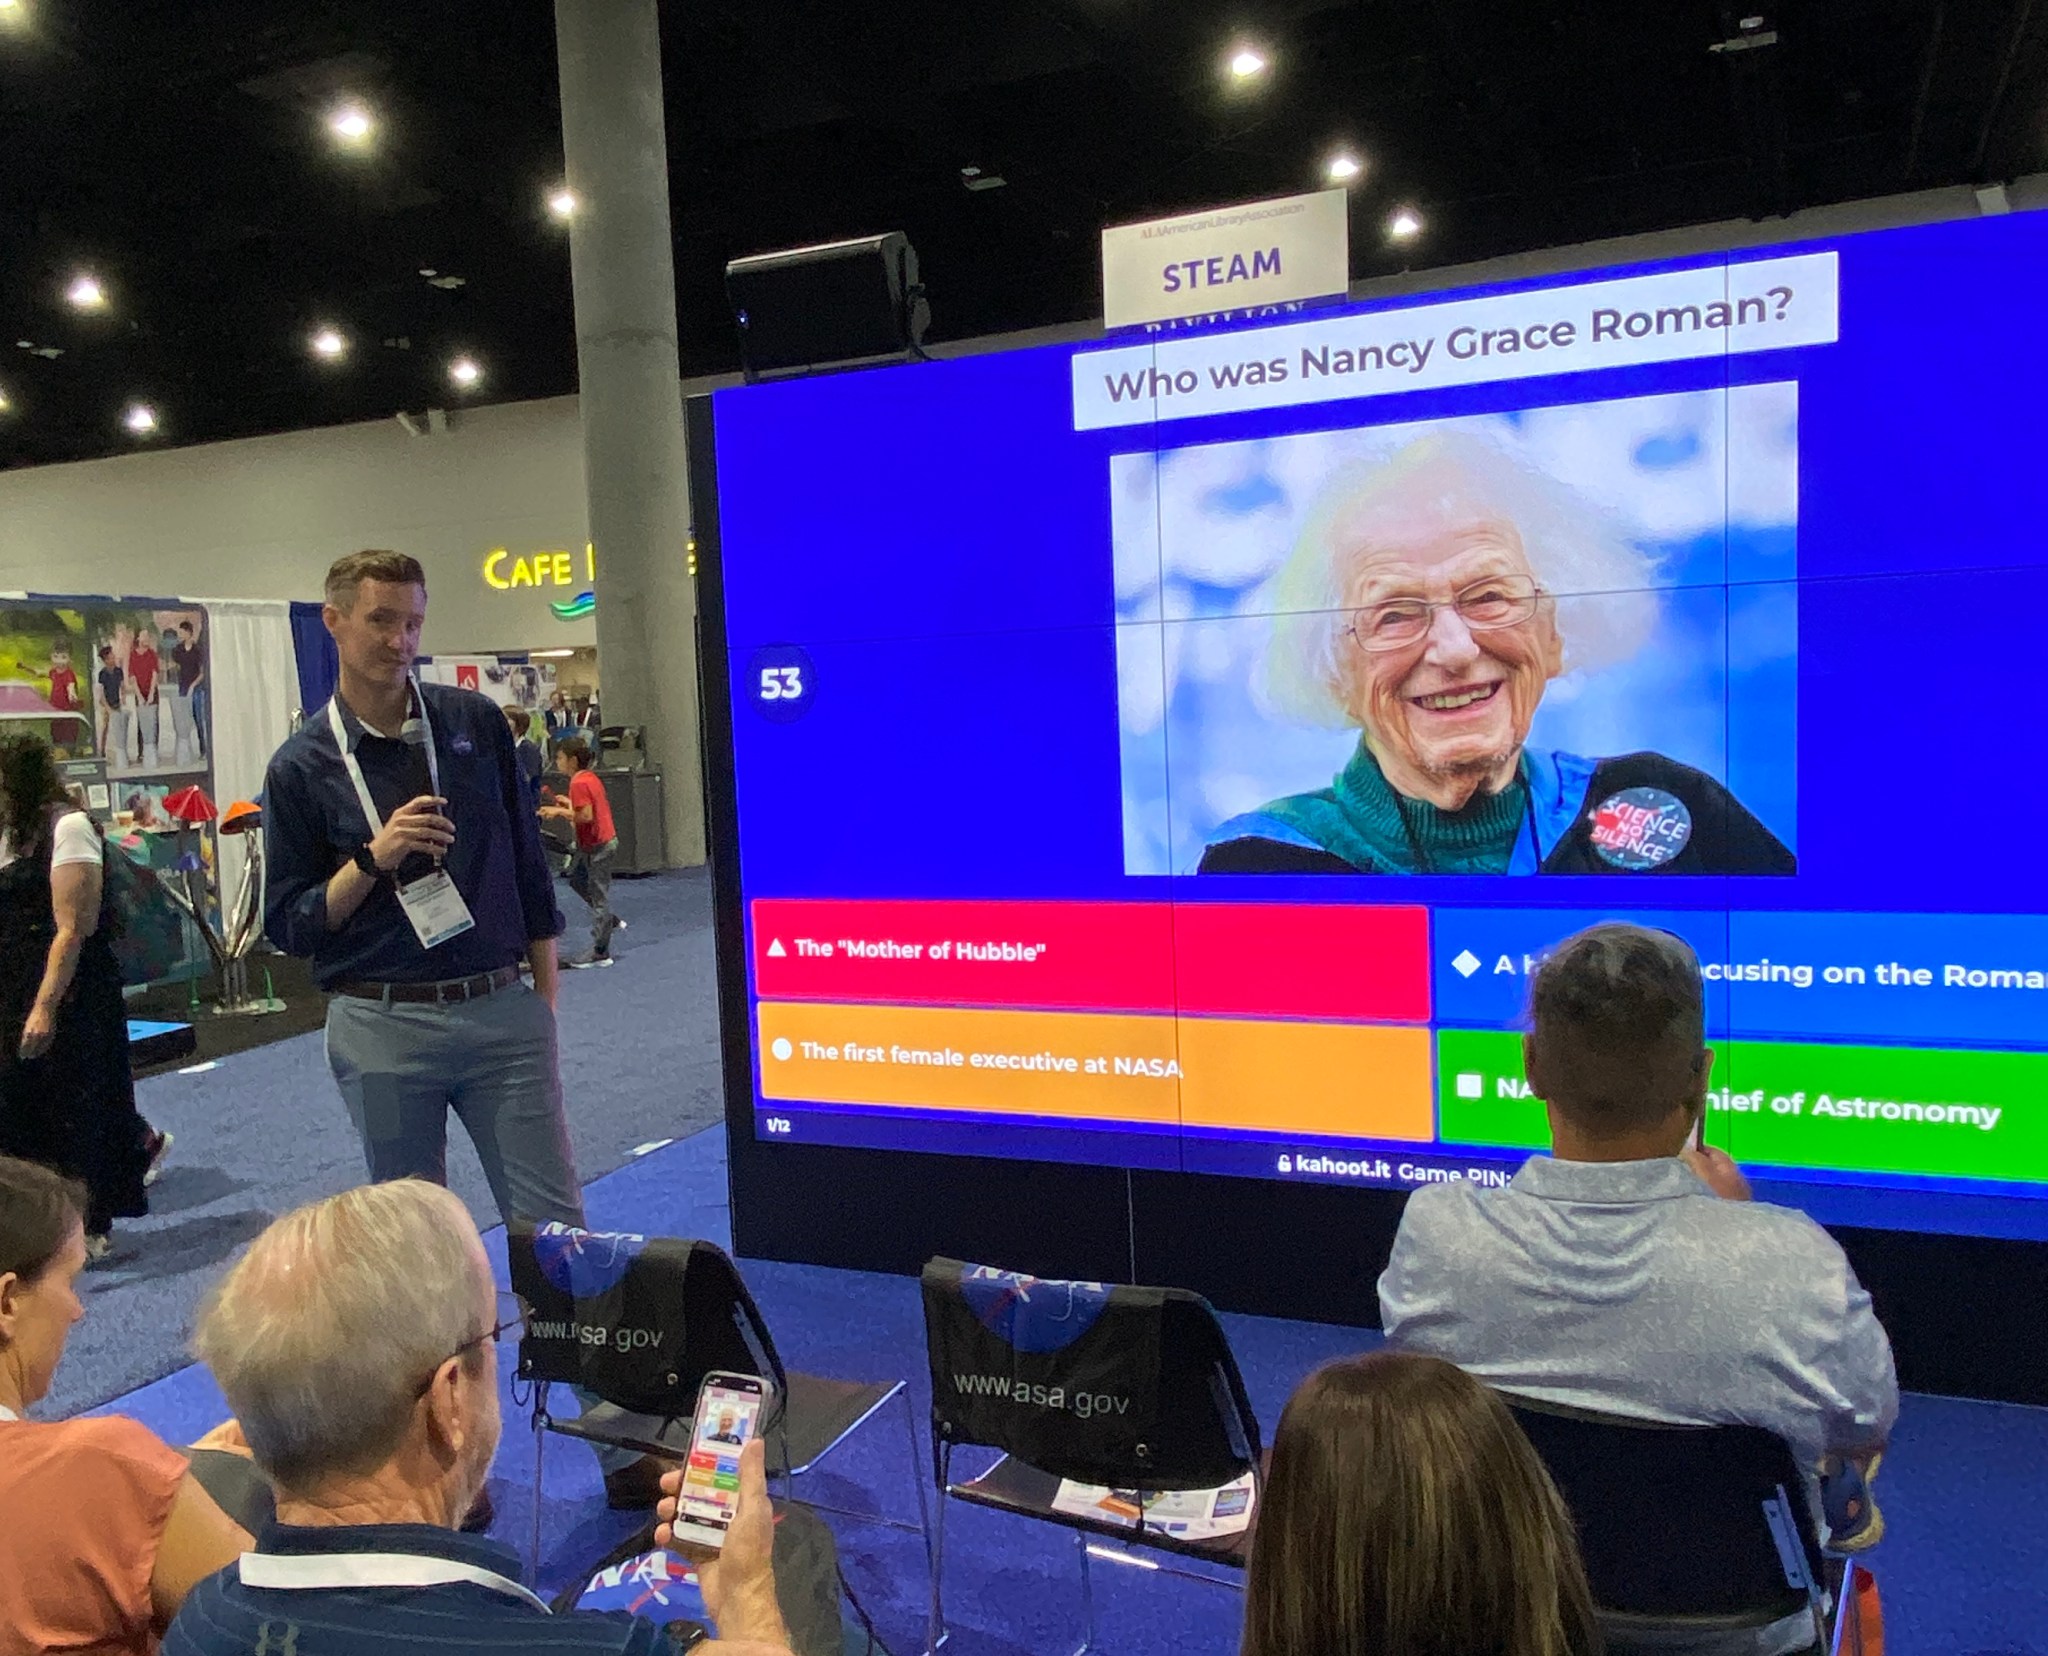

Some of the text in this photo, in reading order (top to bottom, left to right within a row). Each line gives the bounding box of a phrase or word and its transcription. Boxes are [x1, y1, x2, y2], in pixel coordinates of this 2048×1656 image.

[1162, 247, 1282, 293] STEAM
[1105, 285, 1795, 403] Who was Nancy Grace Roman?
[484, 550, 573, 590] CAFE
[760, 666, 803, 700] 53
[1602, 796, 1688, 840] SCIENCE
[1616, 820, 1656, 842] NOT
[1590, 824, 1667, 861] SILENCE
[794, 938, 1047, 962] The "Mother of Hubble"
[1493, 954, 1517, 976] A
[1699, 958, 1814, 988] cusing
[1823, 963, 1866, 985] on
[1874, 962, 1934, 987] the
[1944, 964, 2048, 990] Roma
[800, 1041, 1185, 1079] The first female executive at NASA
[766, 1116, 792, 1133] 1/12
[1703, 1087, 1765, 1113] hief
[1770, 1091, 1806, 1116] of
[1811, 1094, 2003, 1131] Astronomy
[1296, 1154, 1392, 1179] kahoot.it
[1398, 1163, 1463, 1184] Game
